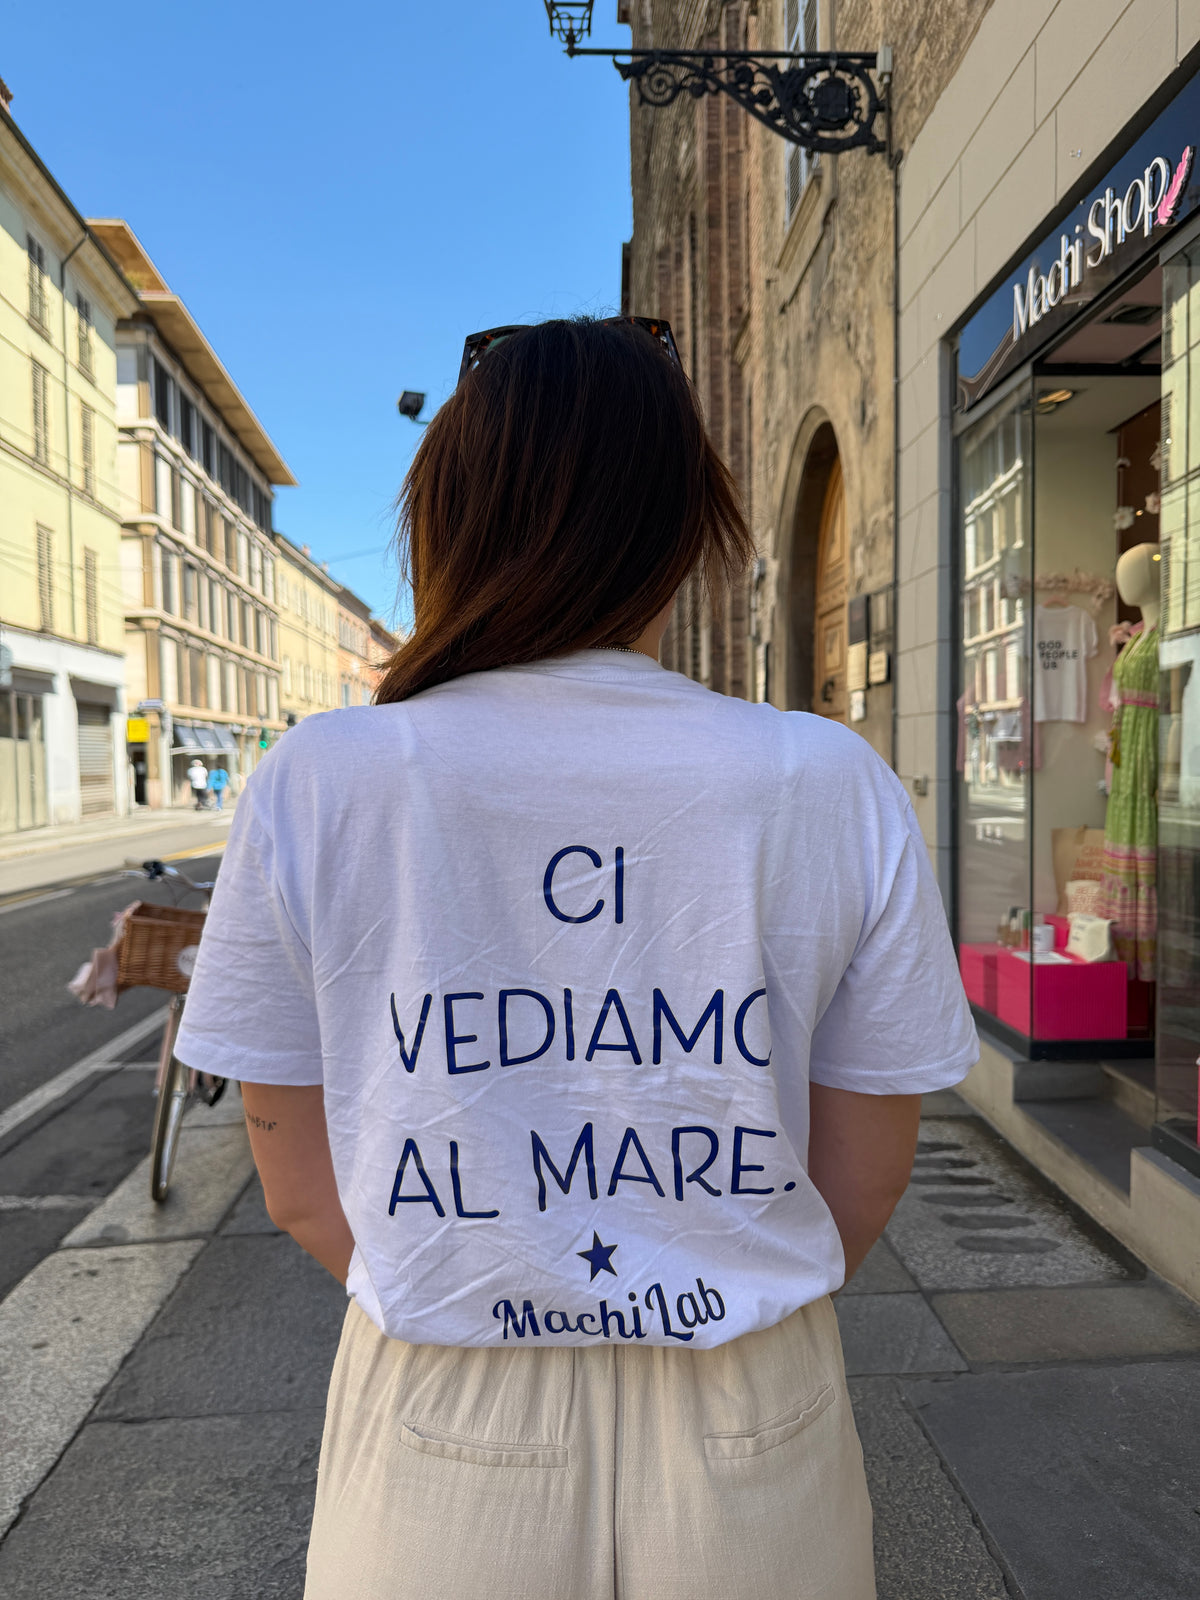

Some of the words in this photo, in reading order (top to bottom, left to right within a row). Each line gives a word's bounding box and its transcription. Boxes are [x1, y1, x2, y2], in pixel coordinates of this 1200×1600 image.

[1013, 224, 1084, 342] Machi
[1087, 156, 1171, 269] Shop
[1040, 650, 1079, 660] PEOPLE
[542, 845, 625, 925] CI
[388, 1137, 500, 1219] AL
[530, 1121, 797, 1212] MARE.
